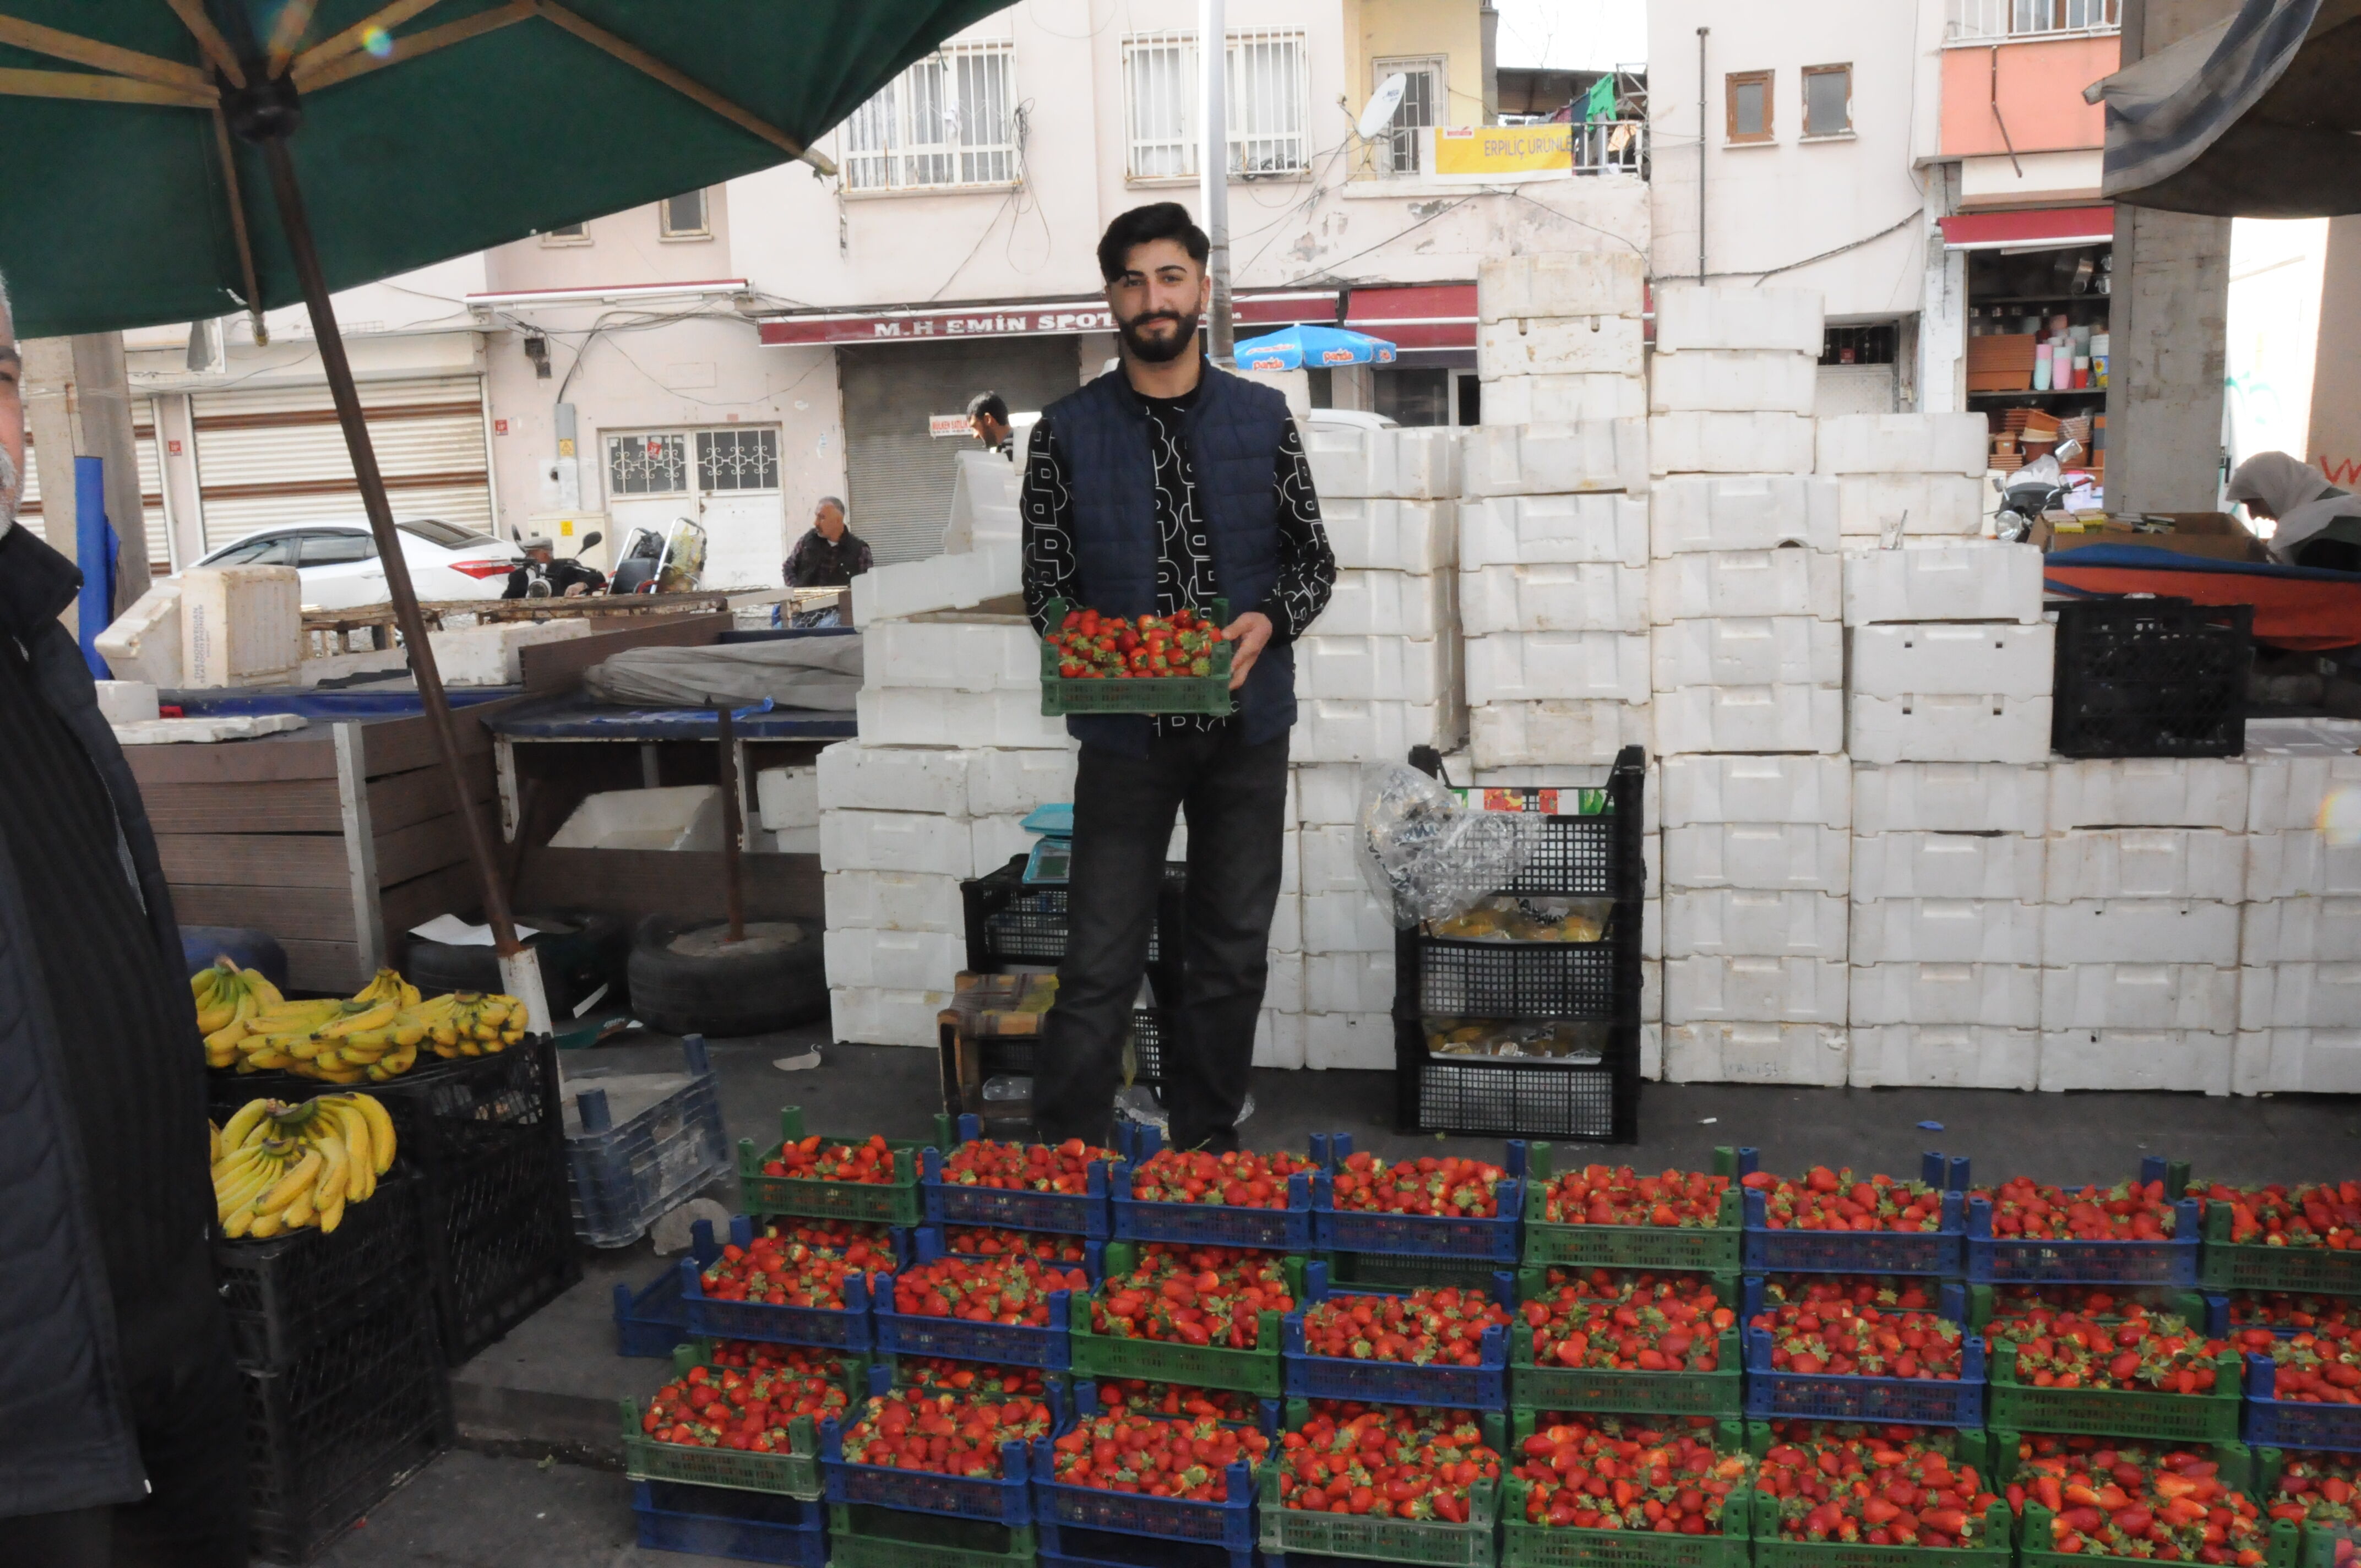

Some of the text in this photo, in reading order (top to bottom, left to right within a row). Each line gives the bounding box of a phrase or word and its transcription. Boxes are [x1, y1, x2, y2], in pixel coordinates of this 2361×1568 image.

[1485, 137, 1525, 159] ERPİLİÇ
[874, 320, 934, 337] M.H
[946, 314, 1027, 334] EMİN
[1253, 358, 1284, 371] panda
[1324, 350, 1353, 363] panda
